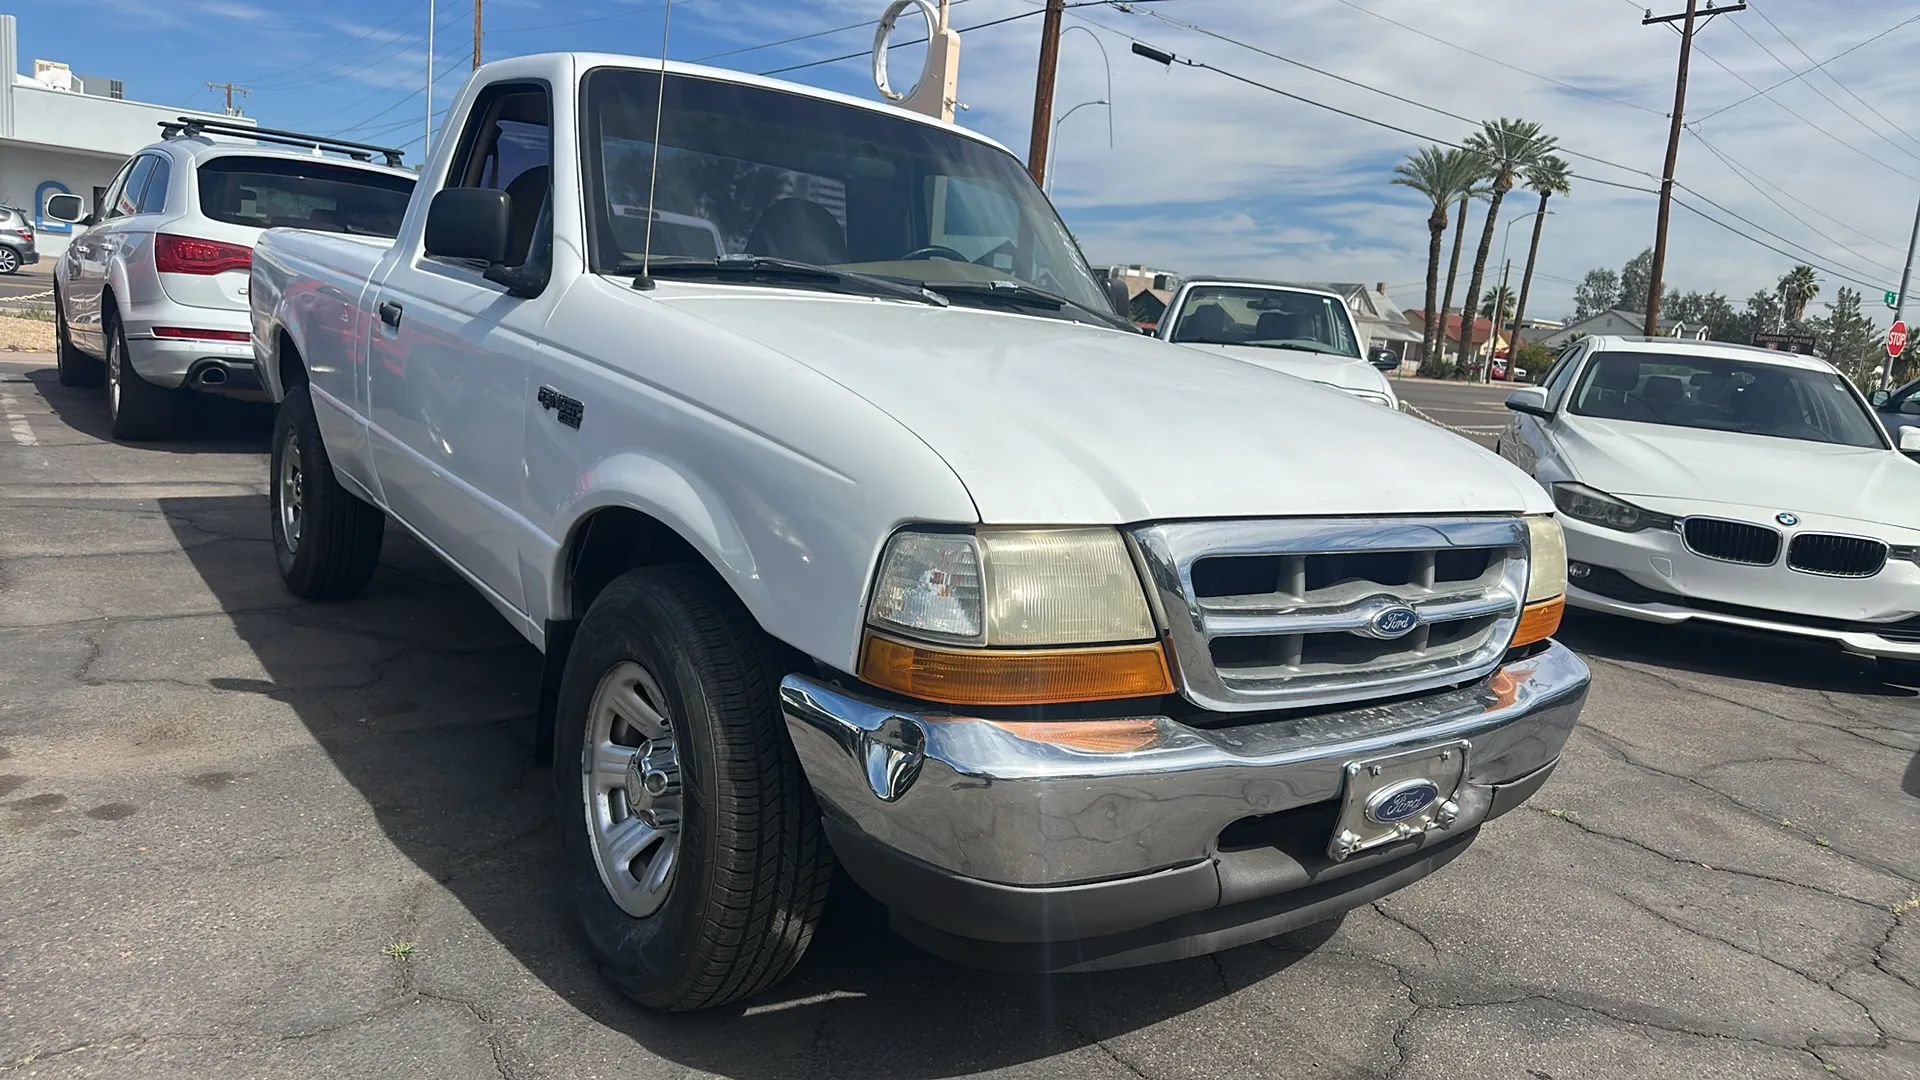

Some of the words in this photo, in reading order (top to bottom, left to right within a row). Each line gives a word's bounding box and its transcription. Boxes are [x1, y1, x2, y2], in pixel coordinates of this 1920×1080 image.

[1789, 336, 1813, 346] Parking
[1888, 332, 1906, 346] STOP
[1382, 612, 1410, 630] Ford
[1386, 789, 1425, 816] Ford
